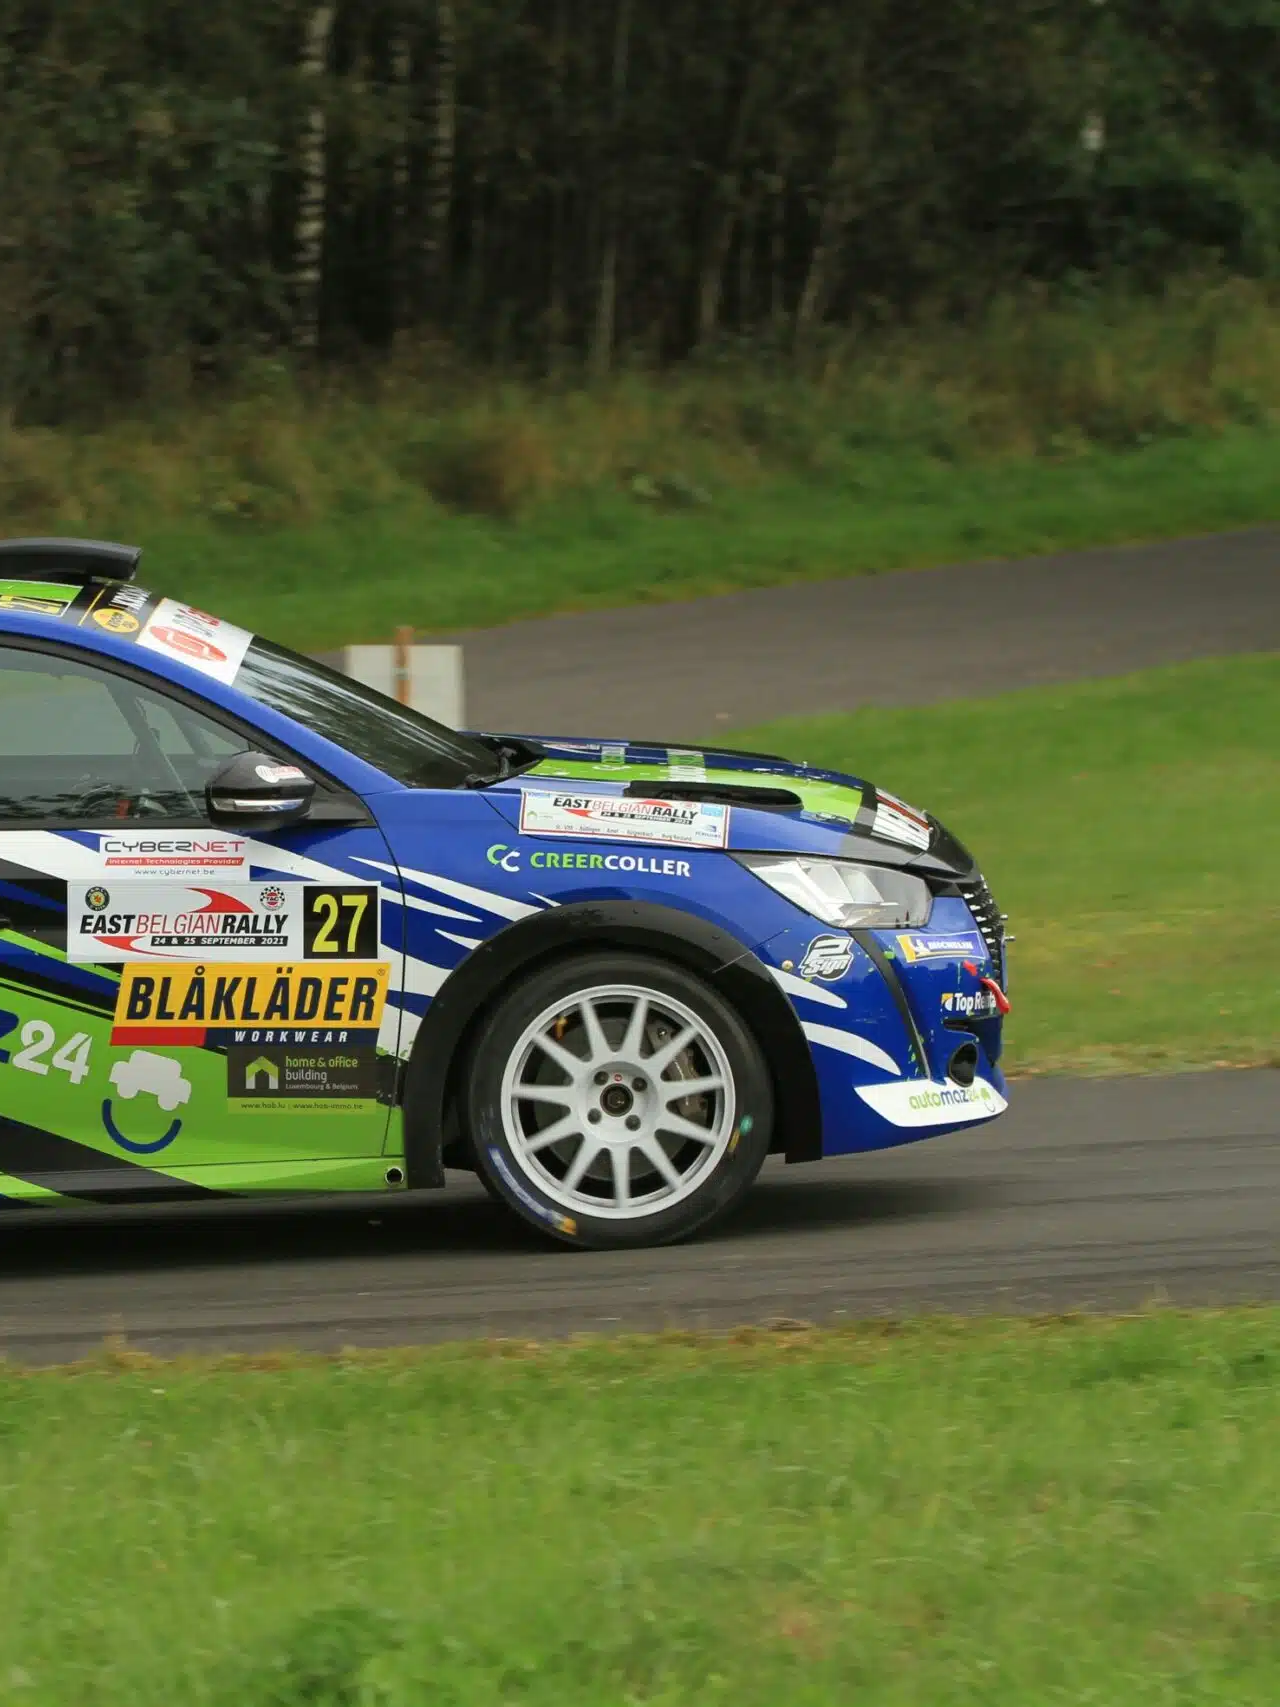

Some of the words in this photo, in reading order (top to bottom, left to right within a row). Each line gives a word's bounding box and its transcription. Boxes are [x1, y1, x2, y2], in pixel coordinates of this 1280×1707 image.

[145, 858, 200, 866] Technologies
[312, 894, 368, 953] 27
[153, 937, 166, 945] 24
[171, 937, 179, 945] &
[184, 937, 196, 945] 25
[201, 937, 257, 945] SEPTEMBER
[262, 937, 285, 945] 2021
[126, 965, 379, 1021] BLÅKLÄDER
[954, 992, 973, 1015] Top
[234, 1030, 348, 1043] WORKWEAR
[285, 1056, 316, 1067] home
[317, 1057, 326, 1067] &
[328, 1056, 358, 1067] office
[285, 1069, 327, 1083] building
